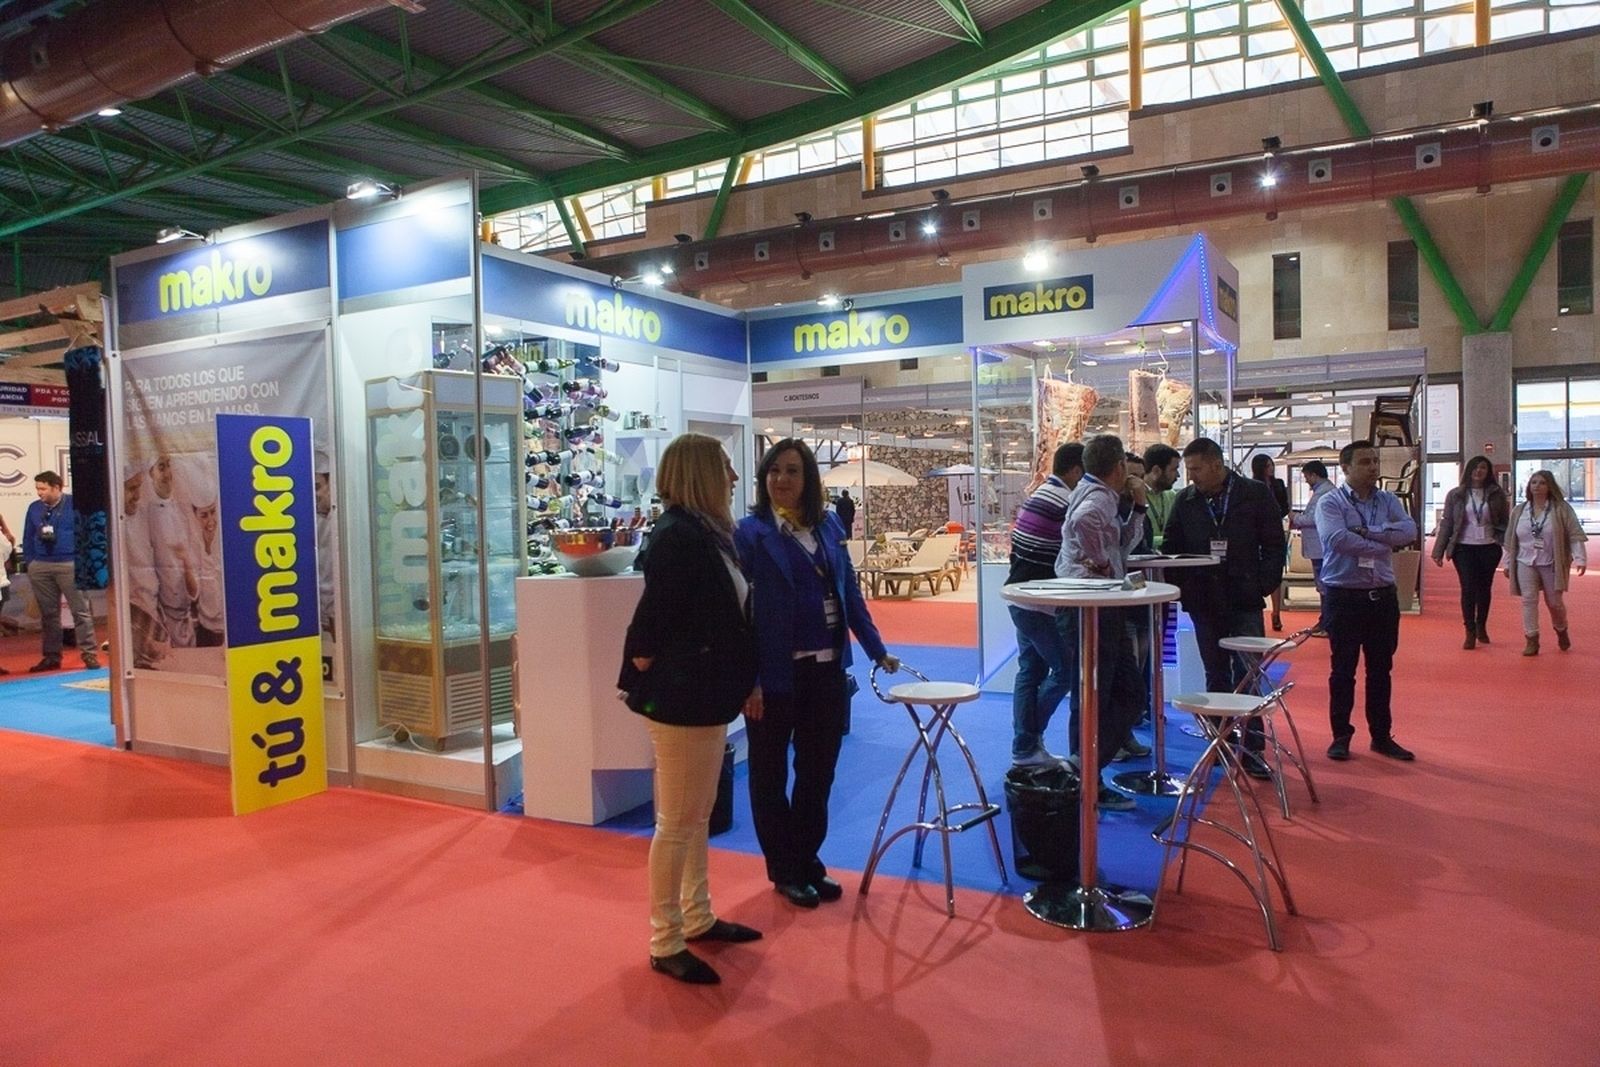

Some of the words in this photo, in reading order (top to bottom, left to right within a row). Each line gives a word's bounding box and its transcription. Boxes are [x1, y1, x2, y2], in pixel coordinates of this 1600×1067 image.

[160, 250, 273, 313] makro
[990, 282, 1087, 318] makro
[564, 291, 662, 342] makro
[793, 308, 909, 352] makro
[127, 395, 163, 413] SIGEN
[166, 385, 248, 408] APRENDIENDO
[251, 381, 279, 398] CON
[154, 373, 191, 391] TODOS
[194, 369, 216, 385] LOS
[219, 365, 245, 382] QUE
[189, 407, 205, 424] EN
[72, 431, 104, 447] SSAL
[240, 425, 300, 634] makro
[251, 656, 304, 705] &
[251, 717, 307, 787] tú
